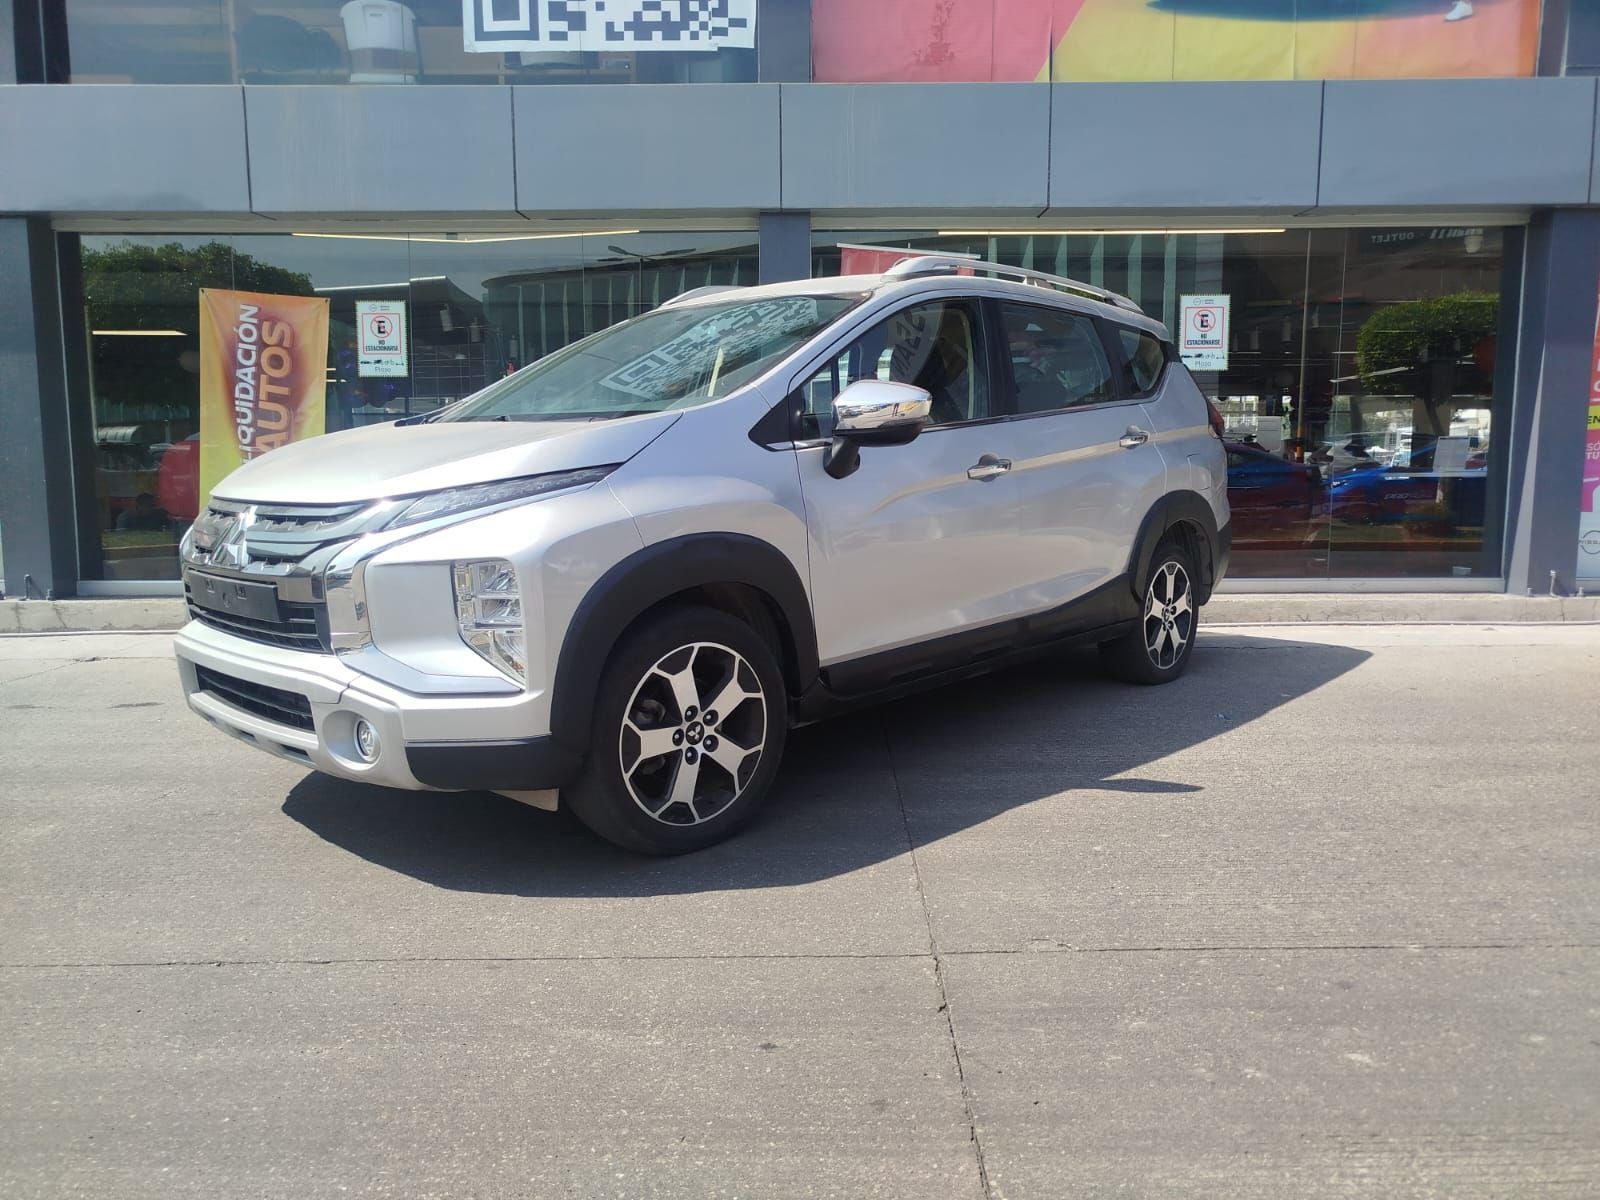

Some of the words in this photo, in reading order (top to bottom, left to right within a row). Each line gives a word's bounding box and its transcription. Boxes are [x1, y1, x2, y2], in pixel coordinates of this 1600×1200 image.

[378, 320, 386, 334] E
[1201, 313, 1209, 328] E
[255, 321, 293, 456] AUTOS
